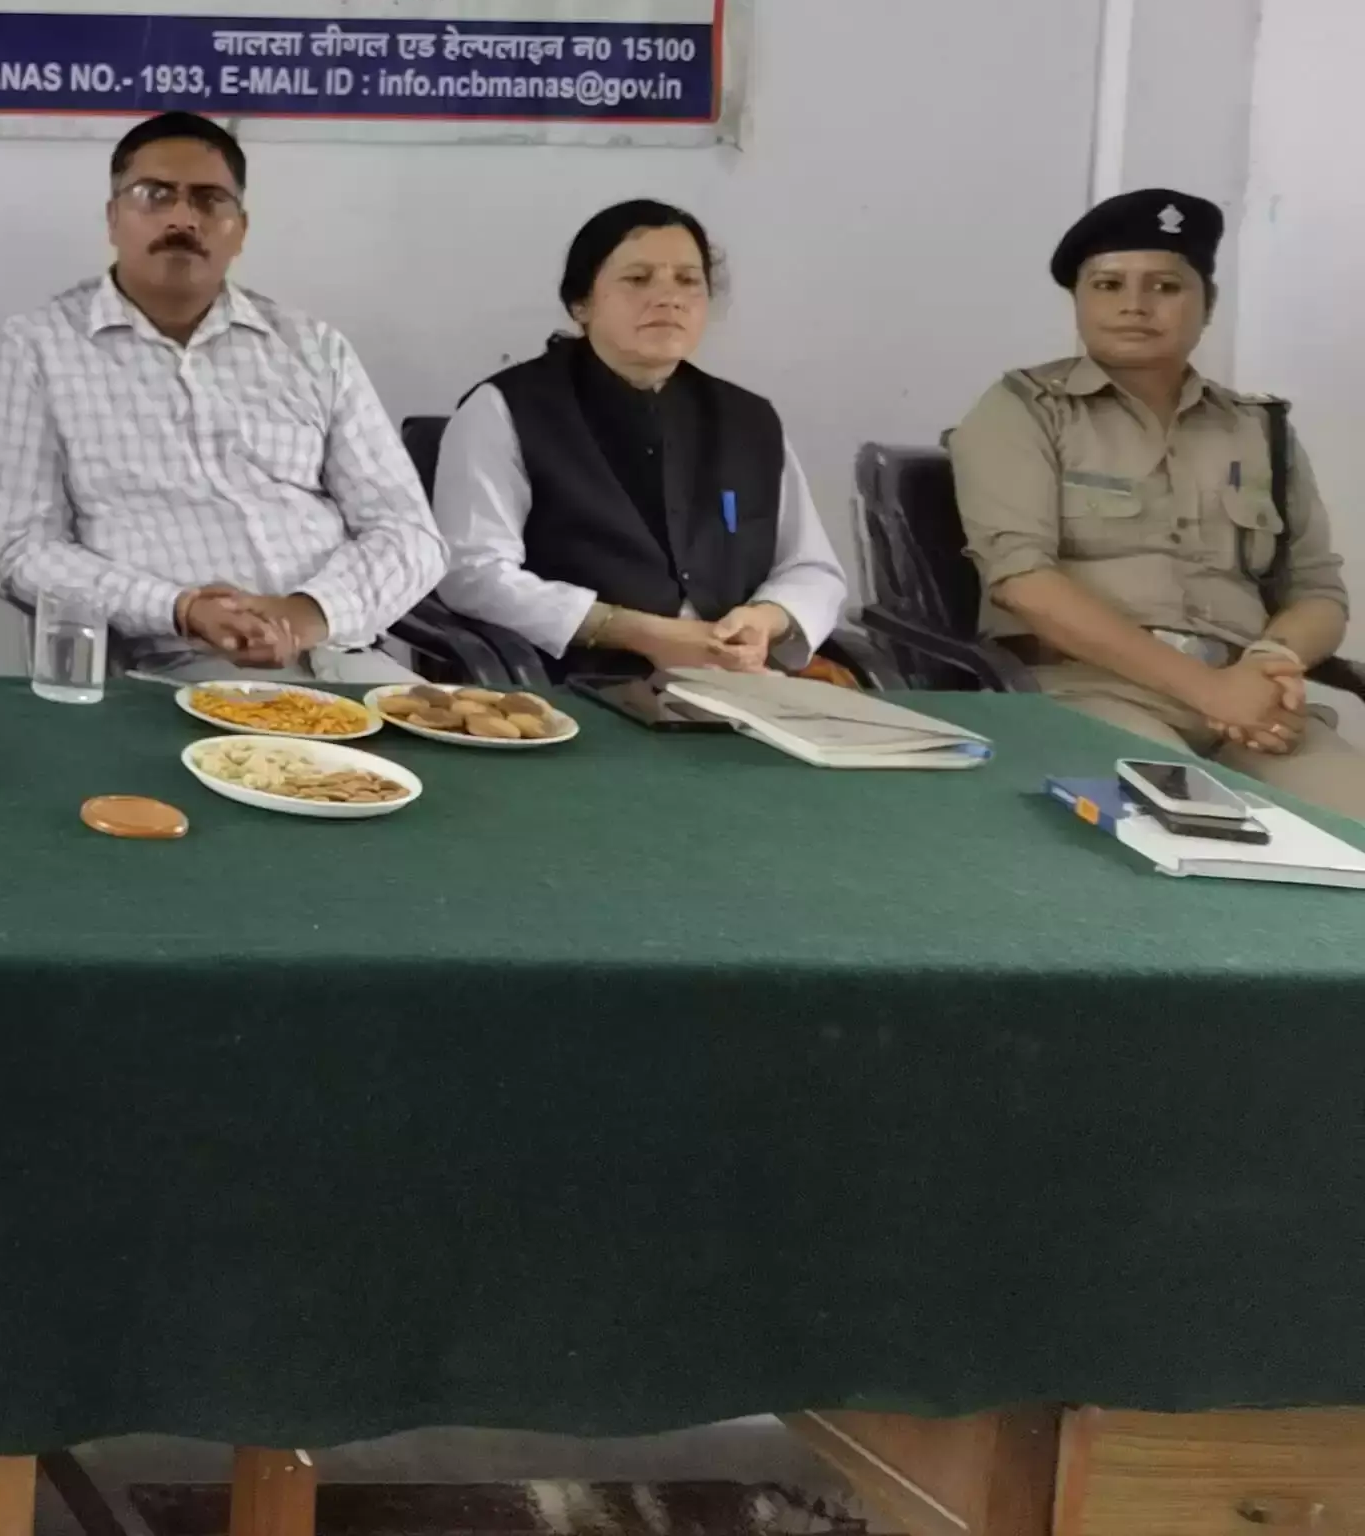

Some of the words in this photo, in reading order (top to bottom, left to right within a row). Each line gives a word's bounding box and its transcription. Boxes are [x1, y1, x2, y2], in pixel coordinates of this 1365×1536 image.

[212, 29, 302, 58] नालसा
[310, 23, 391, 59] लीगल
[397, 31, 435, 61] एड
[442, 24, 564, 64] हेल्पलाइन
[620, 36, 696, 63] 15100
[140, 65, 211, 98] 1933,
[220, 66, 311, 96] E-MAIL
[326, 69, 354, 96] ID
[378, 67, 682, 106] info.ncbmanas@gov.in
